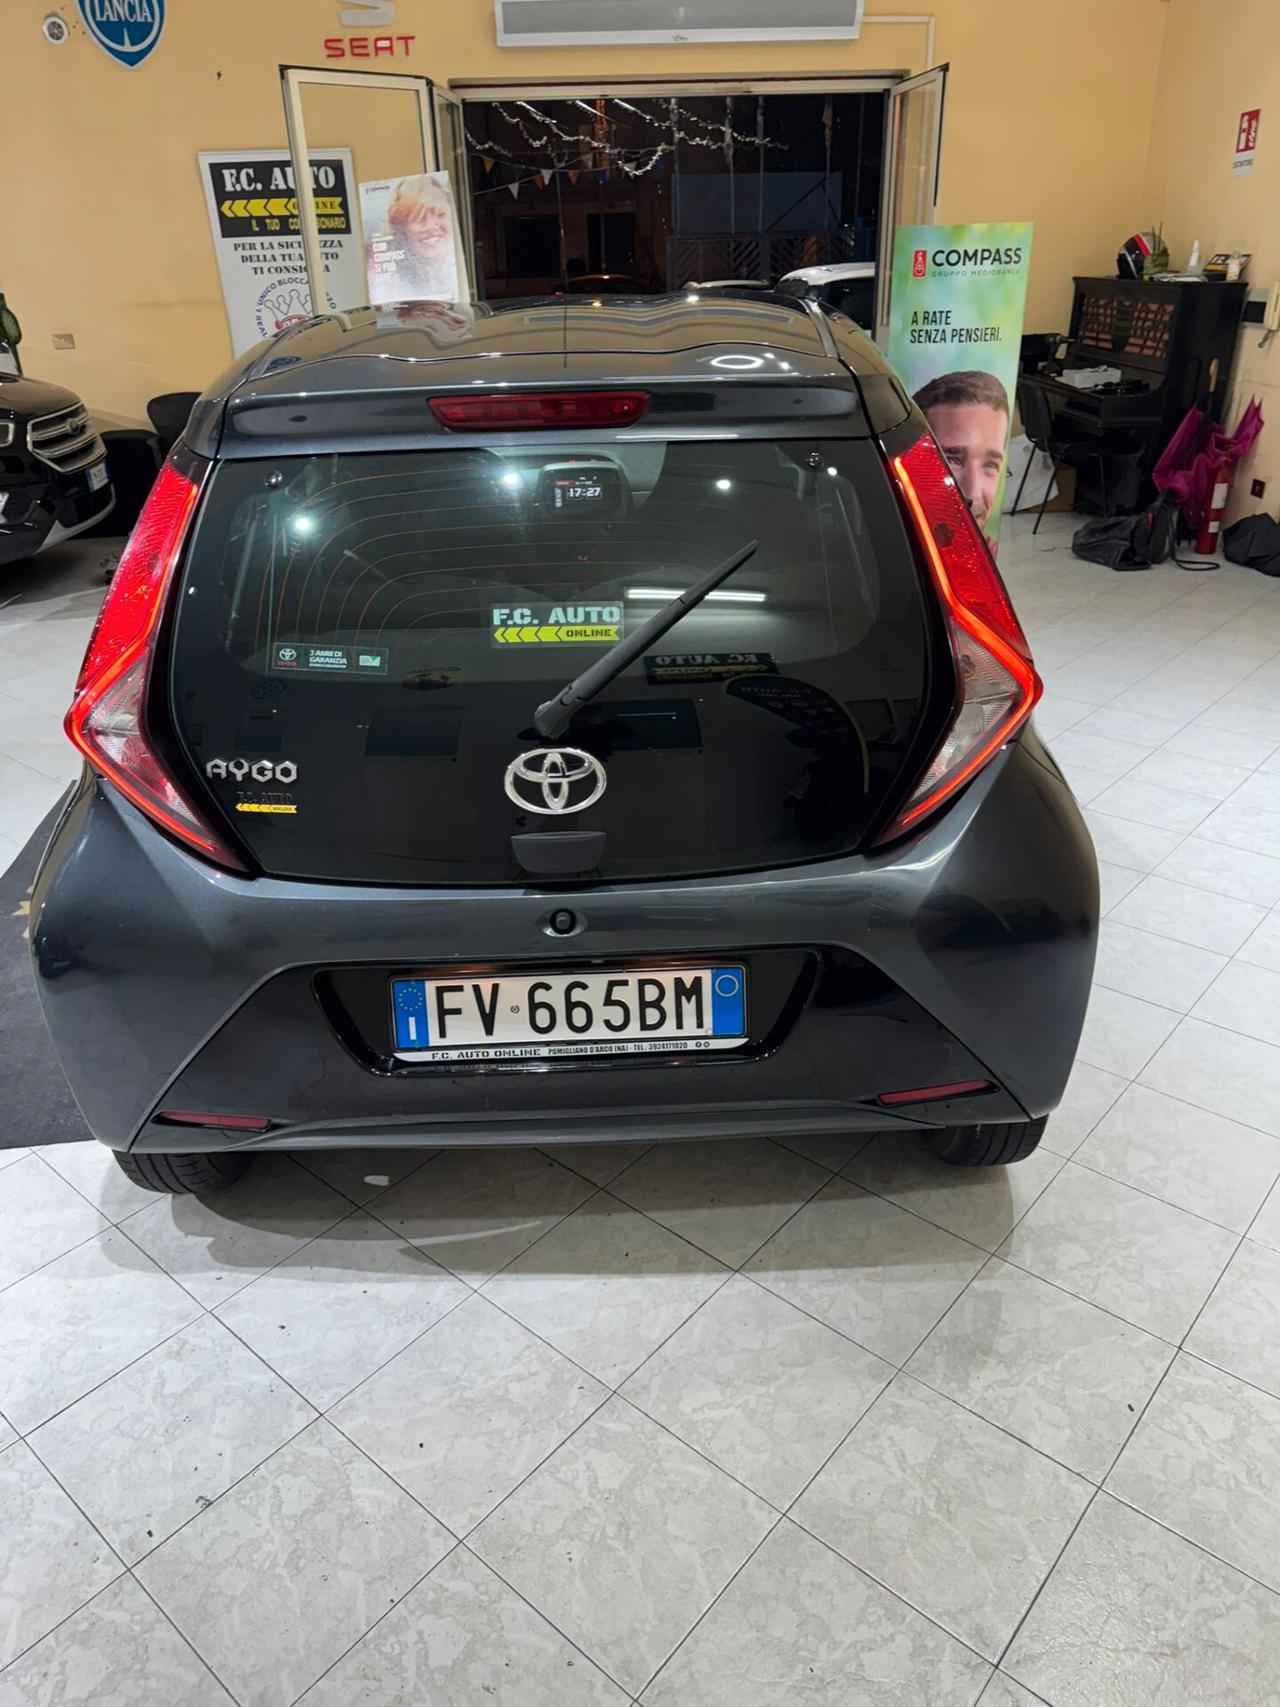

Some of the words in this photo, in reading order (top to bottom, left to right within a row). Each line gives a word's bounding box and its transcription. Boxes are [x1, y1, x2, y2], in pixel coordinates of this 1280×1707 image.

[94, 0, 153, 22] LANCIA
[324, 36, 415, 58] SEAT
[233, 242, 257, 251] PER
[260, 241, 275, 250] LA
[241, 253, 277, 263] DELLA
[932, 247, 1022, 267] COMPASS
[251, 266, 264, 275] TI
[931, 270, 967, 278] GRUPPO
[911, 310, 919, 326] A
[922, 310, 952, 326] RATE
[910, 328, 947, 344] SENZA
[950, 326, 1003, 343] PENSIERI.
[569, 487, 601, 497] 17:27
[493, 608, 539, 625] F.C.
[548, 606, 620, 624] AUTO
[566, 628, 612, 638] ONLINE
[206, 758, 298, 784] AYGO
[435, 982, 500, 1039] FV
[527, 975, 704, 1035] 665BM
[457, 1050, 489, 1059] AUTO
[494, 1048, 541, 1057] ONLINE
